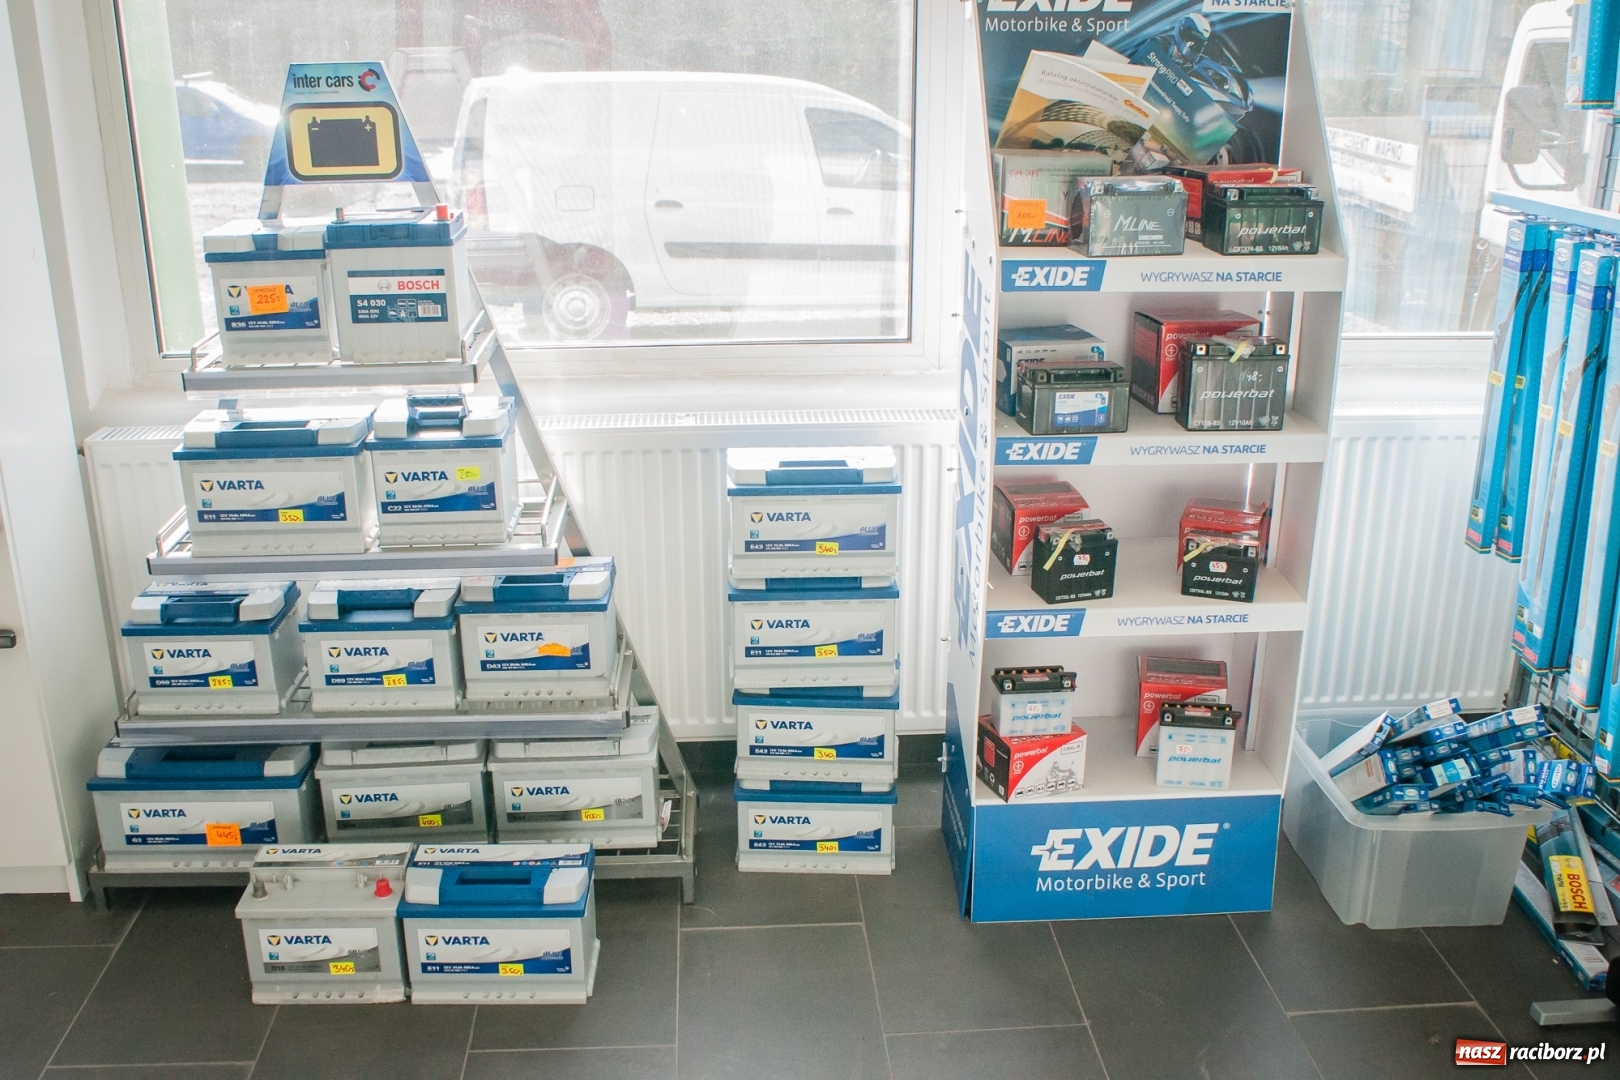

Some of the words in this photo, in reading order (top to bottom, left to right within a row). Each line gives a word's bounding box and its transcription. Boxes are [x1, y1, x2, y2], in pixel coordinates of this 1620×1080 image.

[985, 18, 1066, 32] Motorbike
[1072, 18, 1082, 32] &
[1087, 18, 1129, 33] Sport
[1146, 51, 1180, 84] StrongPRO
[293, 73, 322, 89] inter
[326, 73, 354, 89] cars
[1041, 69, 1068, 81] Katalog
[1069, 77, 1119, 101] akumulatorów
[1114, 214, 1164, 232] M.LINE
[1238, 225, 1306, 237] powerbat
[1011, 267, 1090, 287] EXIDE
[1141, 272, 1214, 282] WYGRYWASZ
[1216, 272, 1233, 282] NA
[1236, 271, 1282, 282] STARCIE
[397, 280, 439, 290] BOSCH
[1200, 389, 1275, 400] powerbat
[1005, 442, 1082, 461] EXIDE
[1130, 446, 1200, 455] WYGRYWASZ
[1203, 445, 1219, 454] NA
[1221, 444, 1266, 454] STARCIE
[401, 471, 448, 481] VARTA
[217, 480, 264, 490] VARTA
[766, 512, 811, 522] VARTA
[1019, 515, 1057, 524] powerbat
[1060, 570, 1105, 580] powerbat
[1193, 575, 1243, 585] powerbat
[766, 620, 810, 629] VARTA
[998, 615, 1071, 633] EXIDE
[1118, 616, 1185, 626] WYGRYWASZ
[1187, 616, 1203, 624] NA
[1206, 614, 1249, 623] STARCIE
[500, 632, 544, 642] VARTA
[167, 649, 211, 658] VARTA
[344, 647, 389, 656] VARTA
[1012, 712, 1061, 721] powerbat
[770, 721, 813, 730] VARTA
[1014, 747, 1048, 760] powerbat
[1168, 756, 1221, 764] powerbat
[526, 787, 570, 796] VARTA
[355, 793, 398, 802] VARTA
[143, 809, 186, 818] VARTA
[769, 816, 811, 825] VARTA
[1030, 823, 1219, 871] EXIDE
[1036, 874, 1133, 892] Motorbike
[1138, 874, 1150, 888] &
[1156, 872, 1205, 890] Sport
[1567, 873, 1587, 910] BOSCH
[284, 935, 332, 945] VARTA
[442, 936, 490, 945] VARTA
